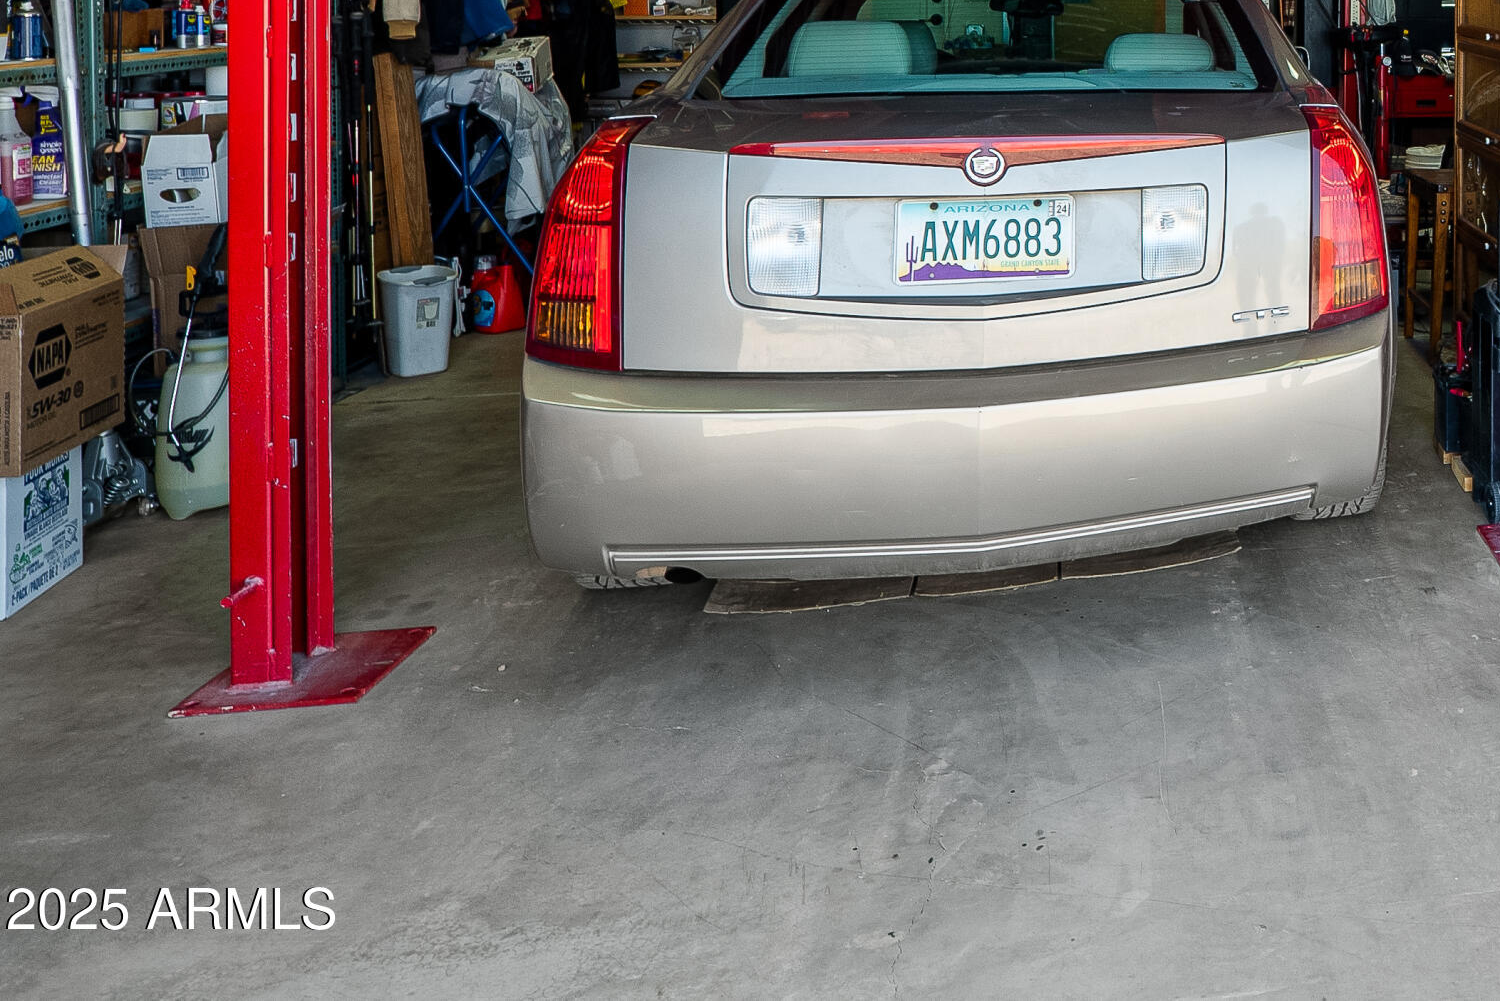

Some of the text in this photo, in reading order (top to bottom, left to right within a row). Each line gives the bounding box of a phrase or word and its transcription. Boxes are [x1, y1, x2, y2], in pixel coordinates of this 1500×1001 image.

[943, 203, 1067, 214] ARIZONA 24
[920, 217, 1062, 262] AXM6883
[1000, 258, 1060, 268] GRAND CANYON STATE
[36, 338, 65, 375] NAPA
[31, 386, 72, 418] 5W-30
